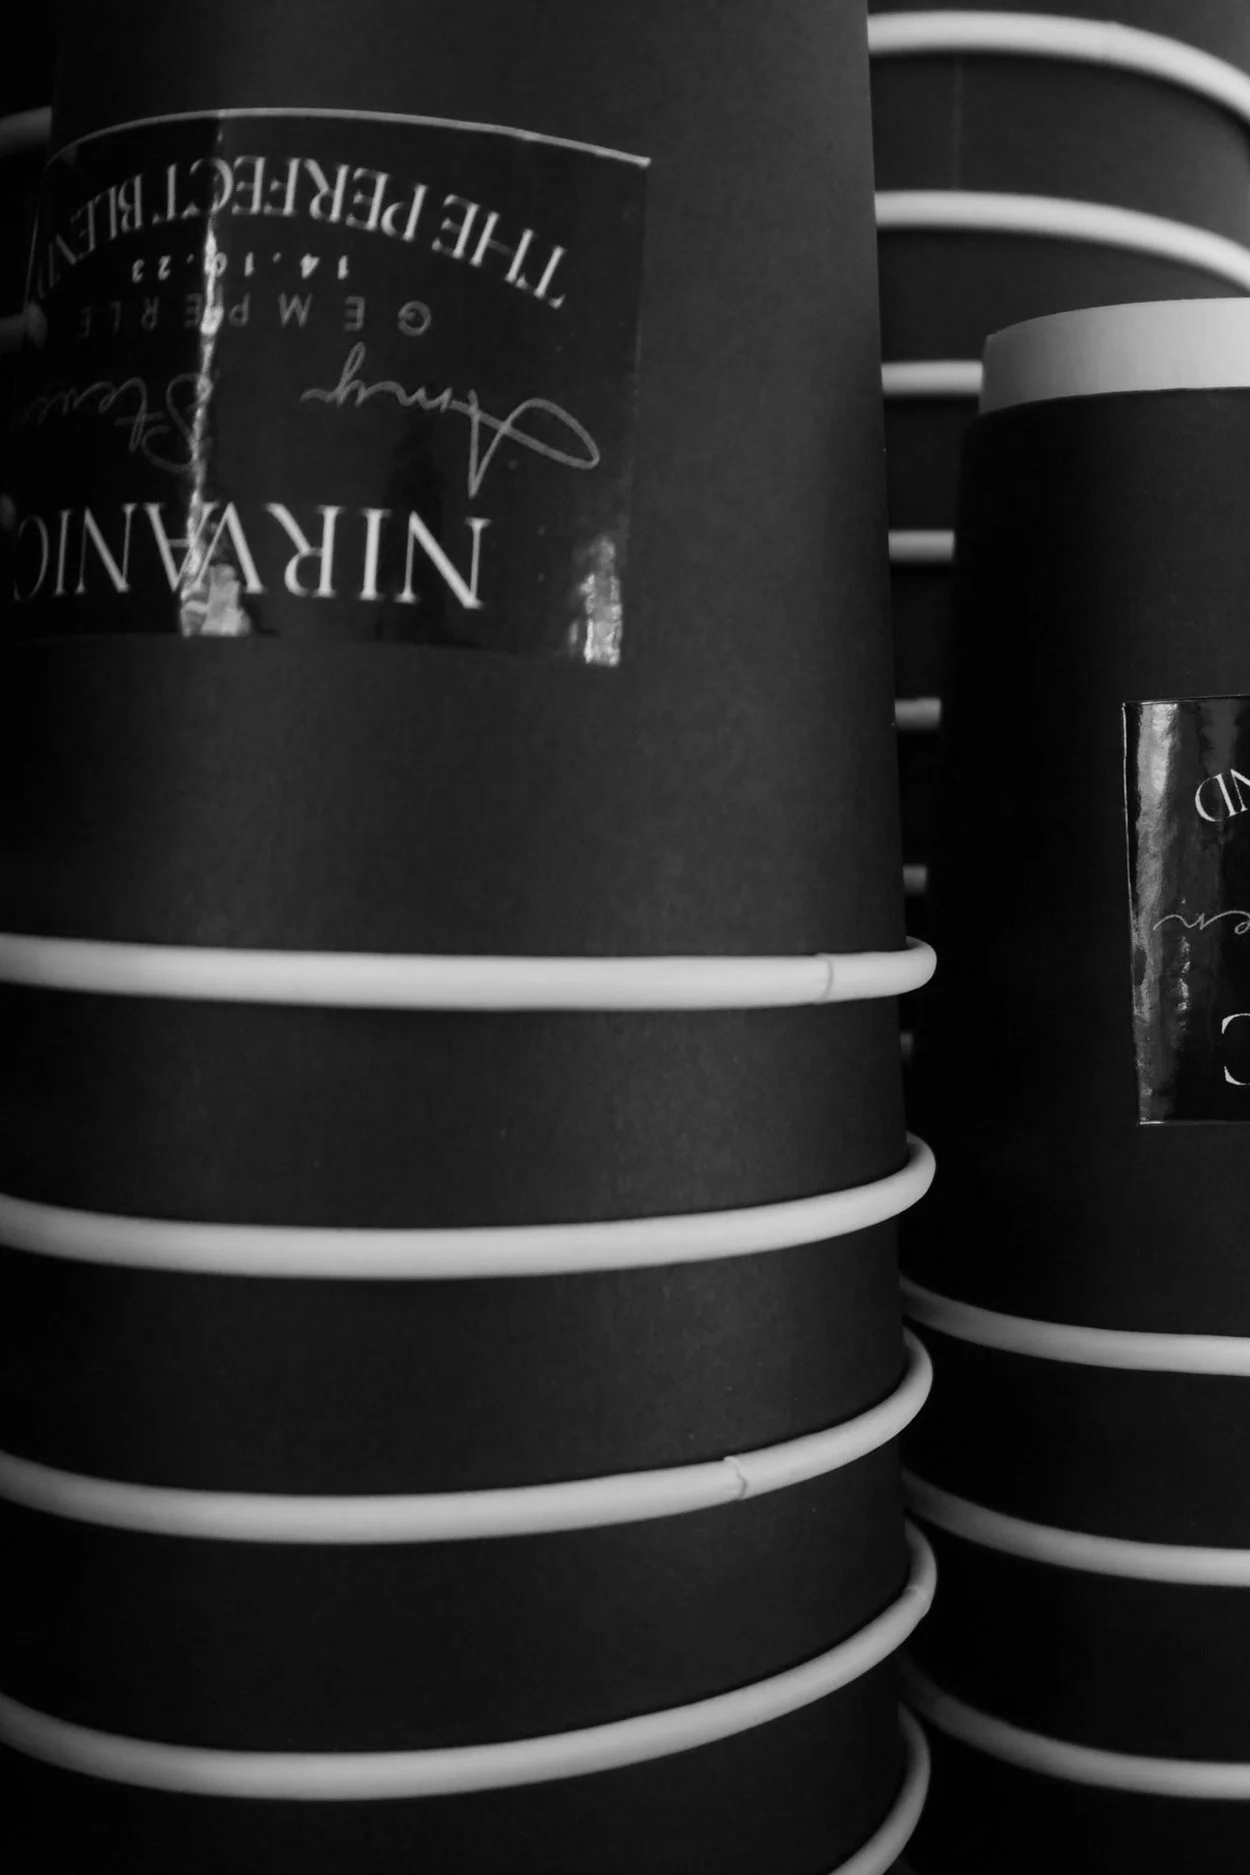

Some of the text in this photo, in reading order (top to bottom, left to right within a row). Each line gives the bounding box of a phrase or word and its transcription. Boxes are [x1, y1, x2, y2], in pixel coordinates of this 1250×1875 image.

[153, 156, 429, 242] PERFECT
[132, 253, 350, 283] 14.10.23
[432, 194, 566, 308] THE
[78, 292, 431, 337] GEMPERLE
